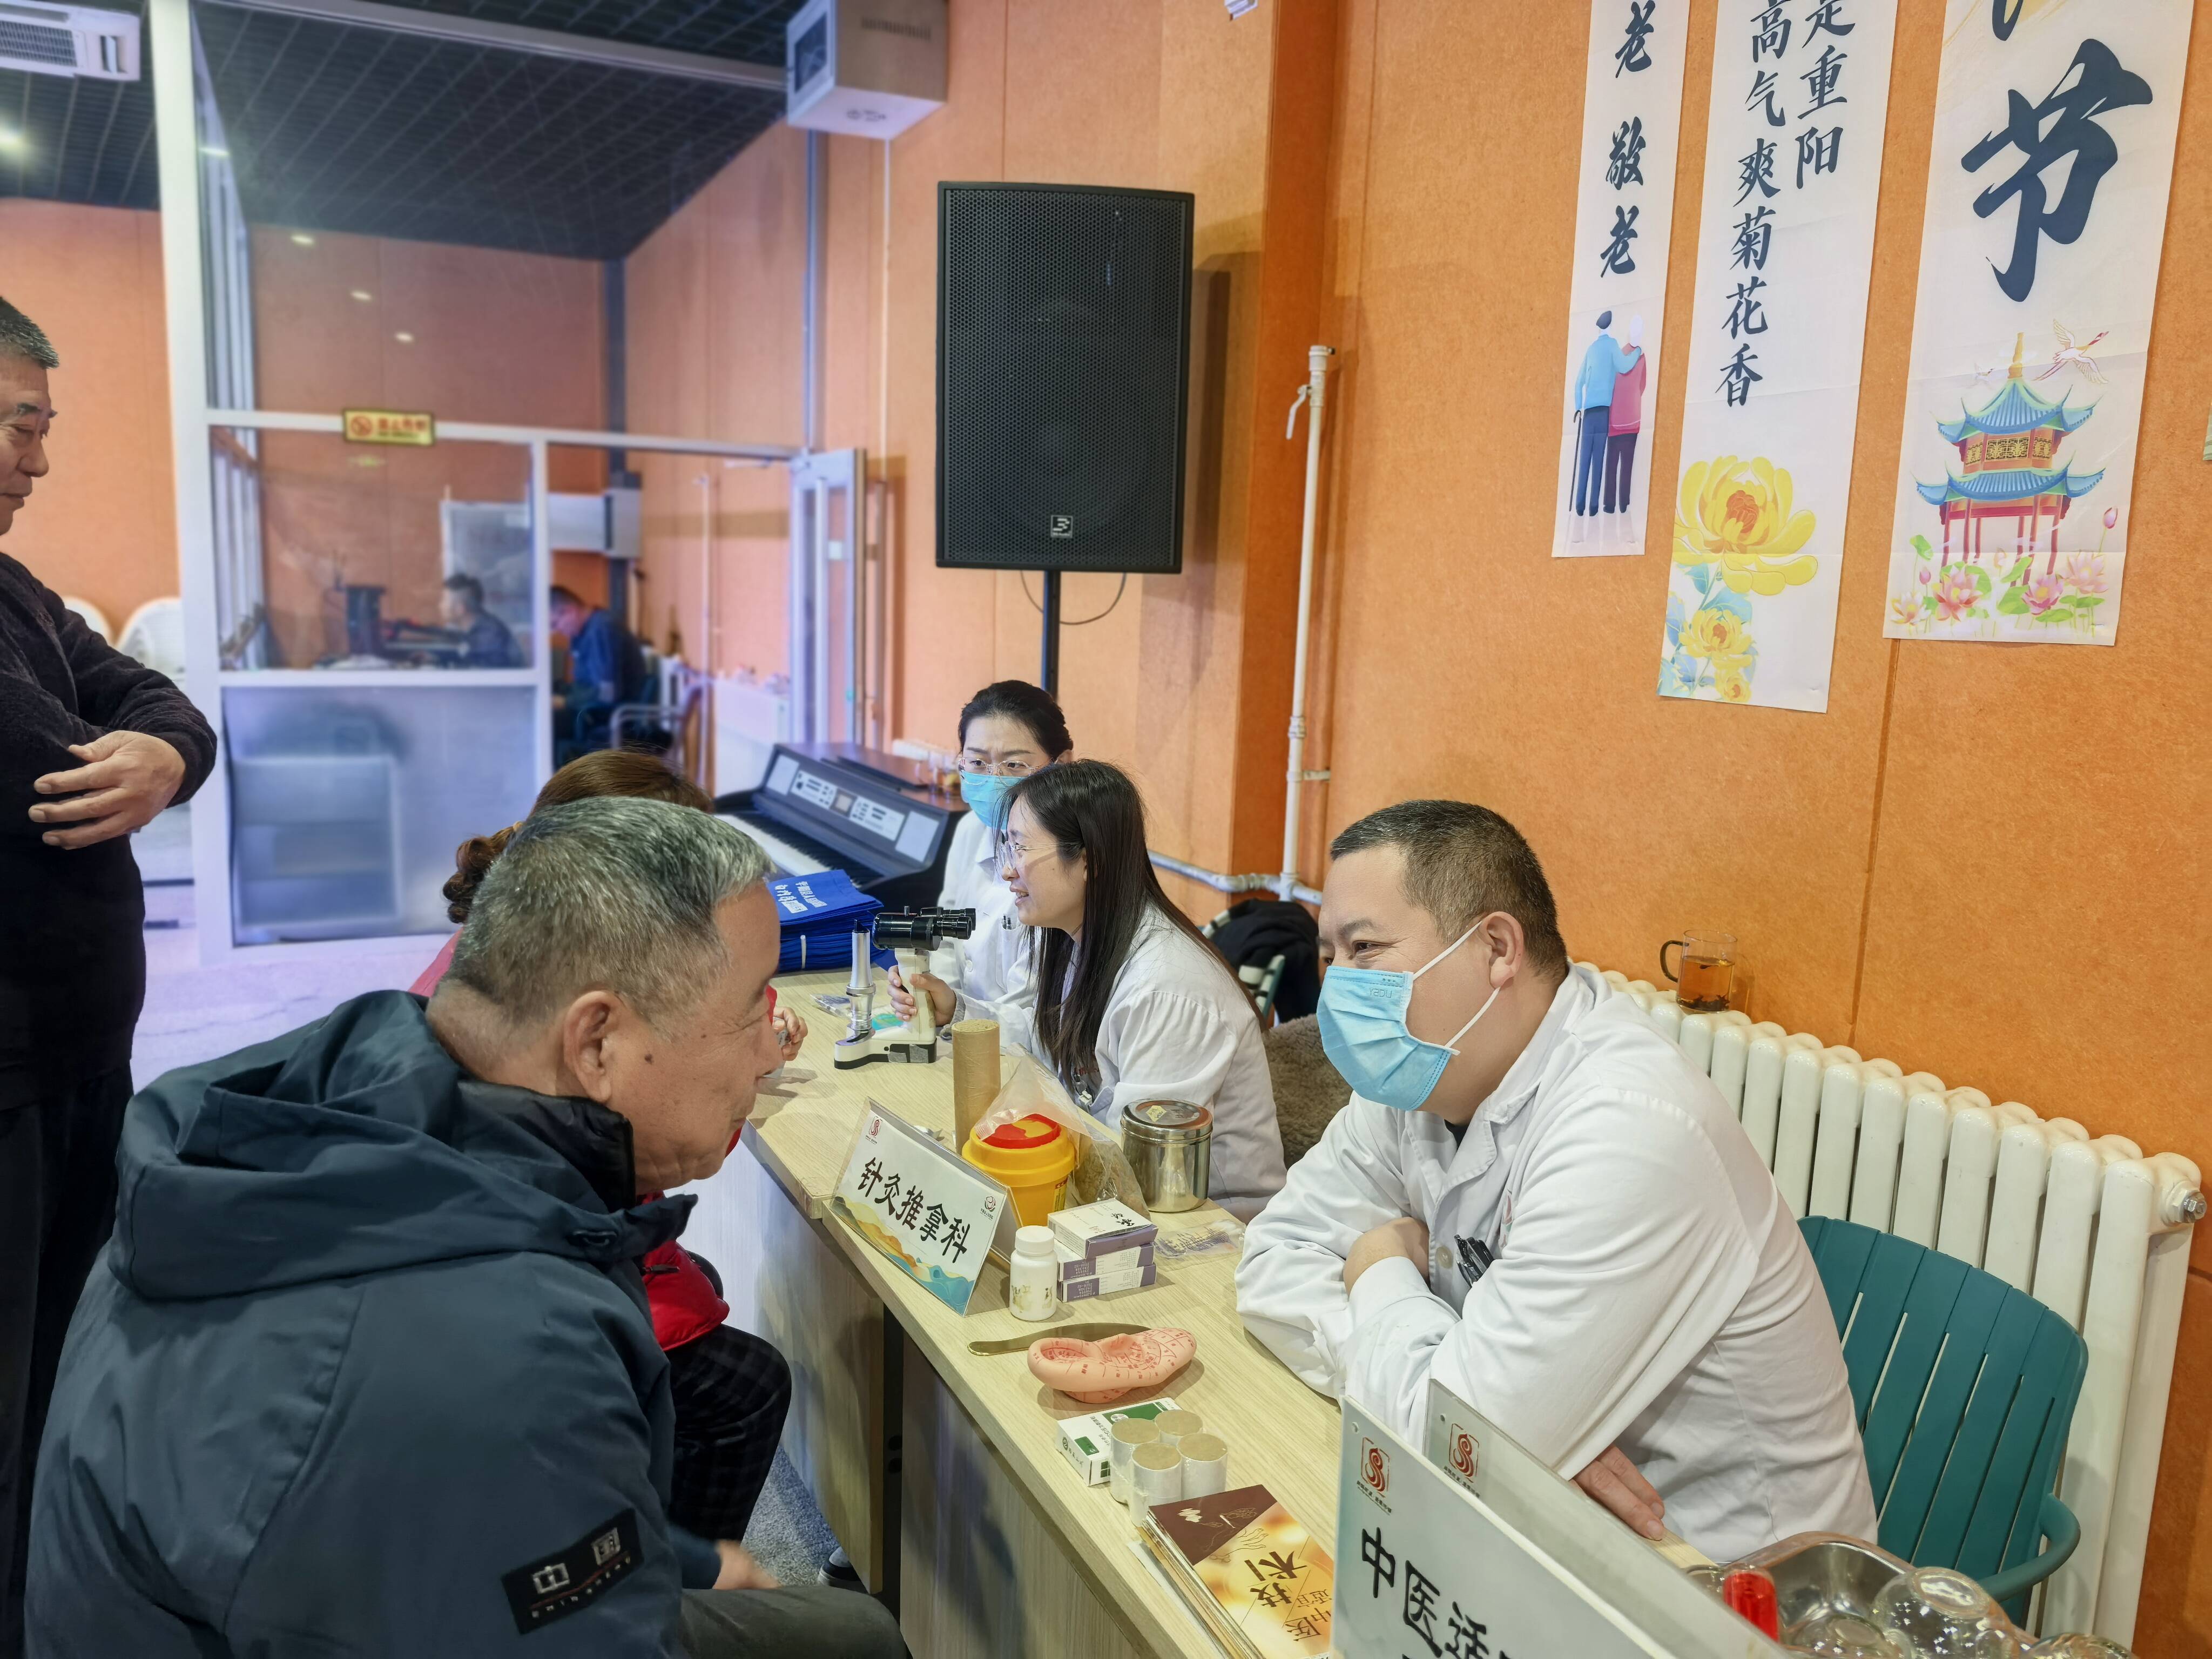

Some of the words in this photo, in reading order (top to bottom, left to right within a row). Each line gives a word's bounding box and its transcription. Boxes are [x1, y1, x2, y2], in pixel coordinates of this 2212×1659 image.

[1716, 0, 1793, 407] 高气爽菊花香
[1960, 0, 2153, 302] 节
[858, 1157, 970, 1263] 针灸推拿科
[1285, 1608, 1331, 1642] 中医
[1362, 1527, 1512, 1659] 中医适
